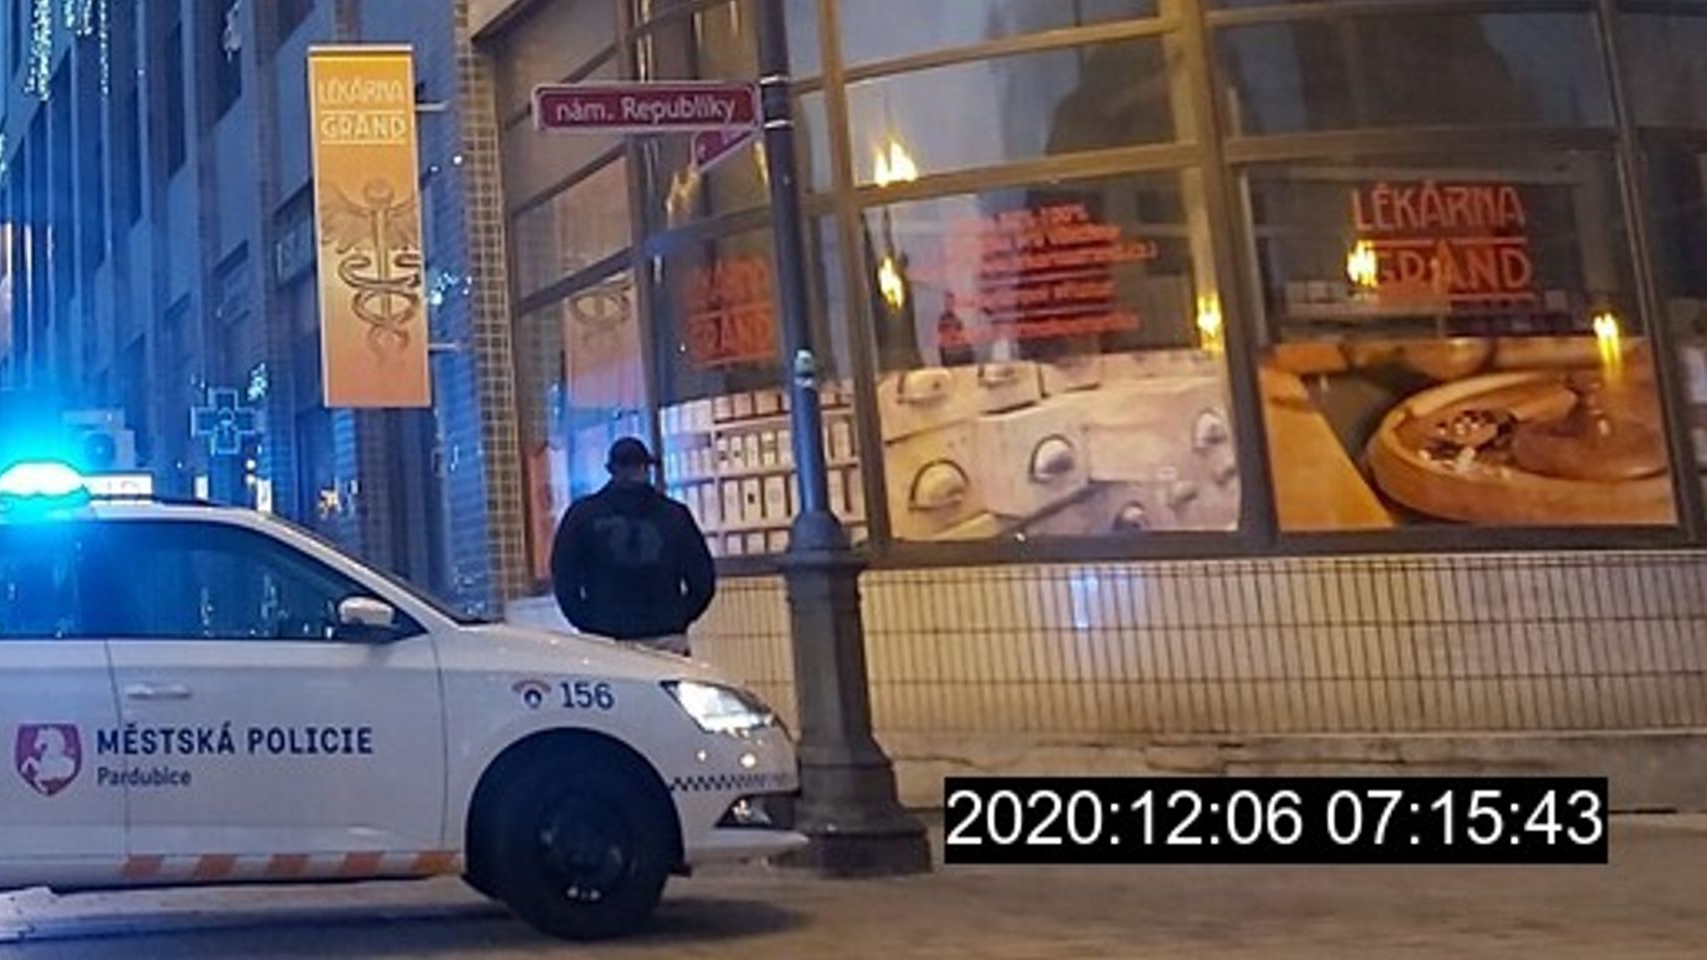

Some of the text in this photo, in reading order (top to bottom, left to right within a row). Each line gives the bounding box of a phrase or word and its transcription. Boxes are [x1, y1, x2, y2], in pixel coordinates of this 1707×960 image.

[555, 95, 736, 126] nám. Republiky
[320, 114, 407, 139] GRAND
[1351, 180, 1526, 231] LÉKÁRNA
[559, 681, 615, 710] 156
[96, 722, 374, 755] MĚSTSKÁ POLICIE
[97, 766, 192, 787] Pardubice
